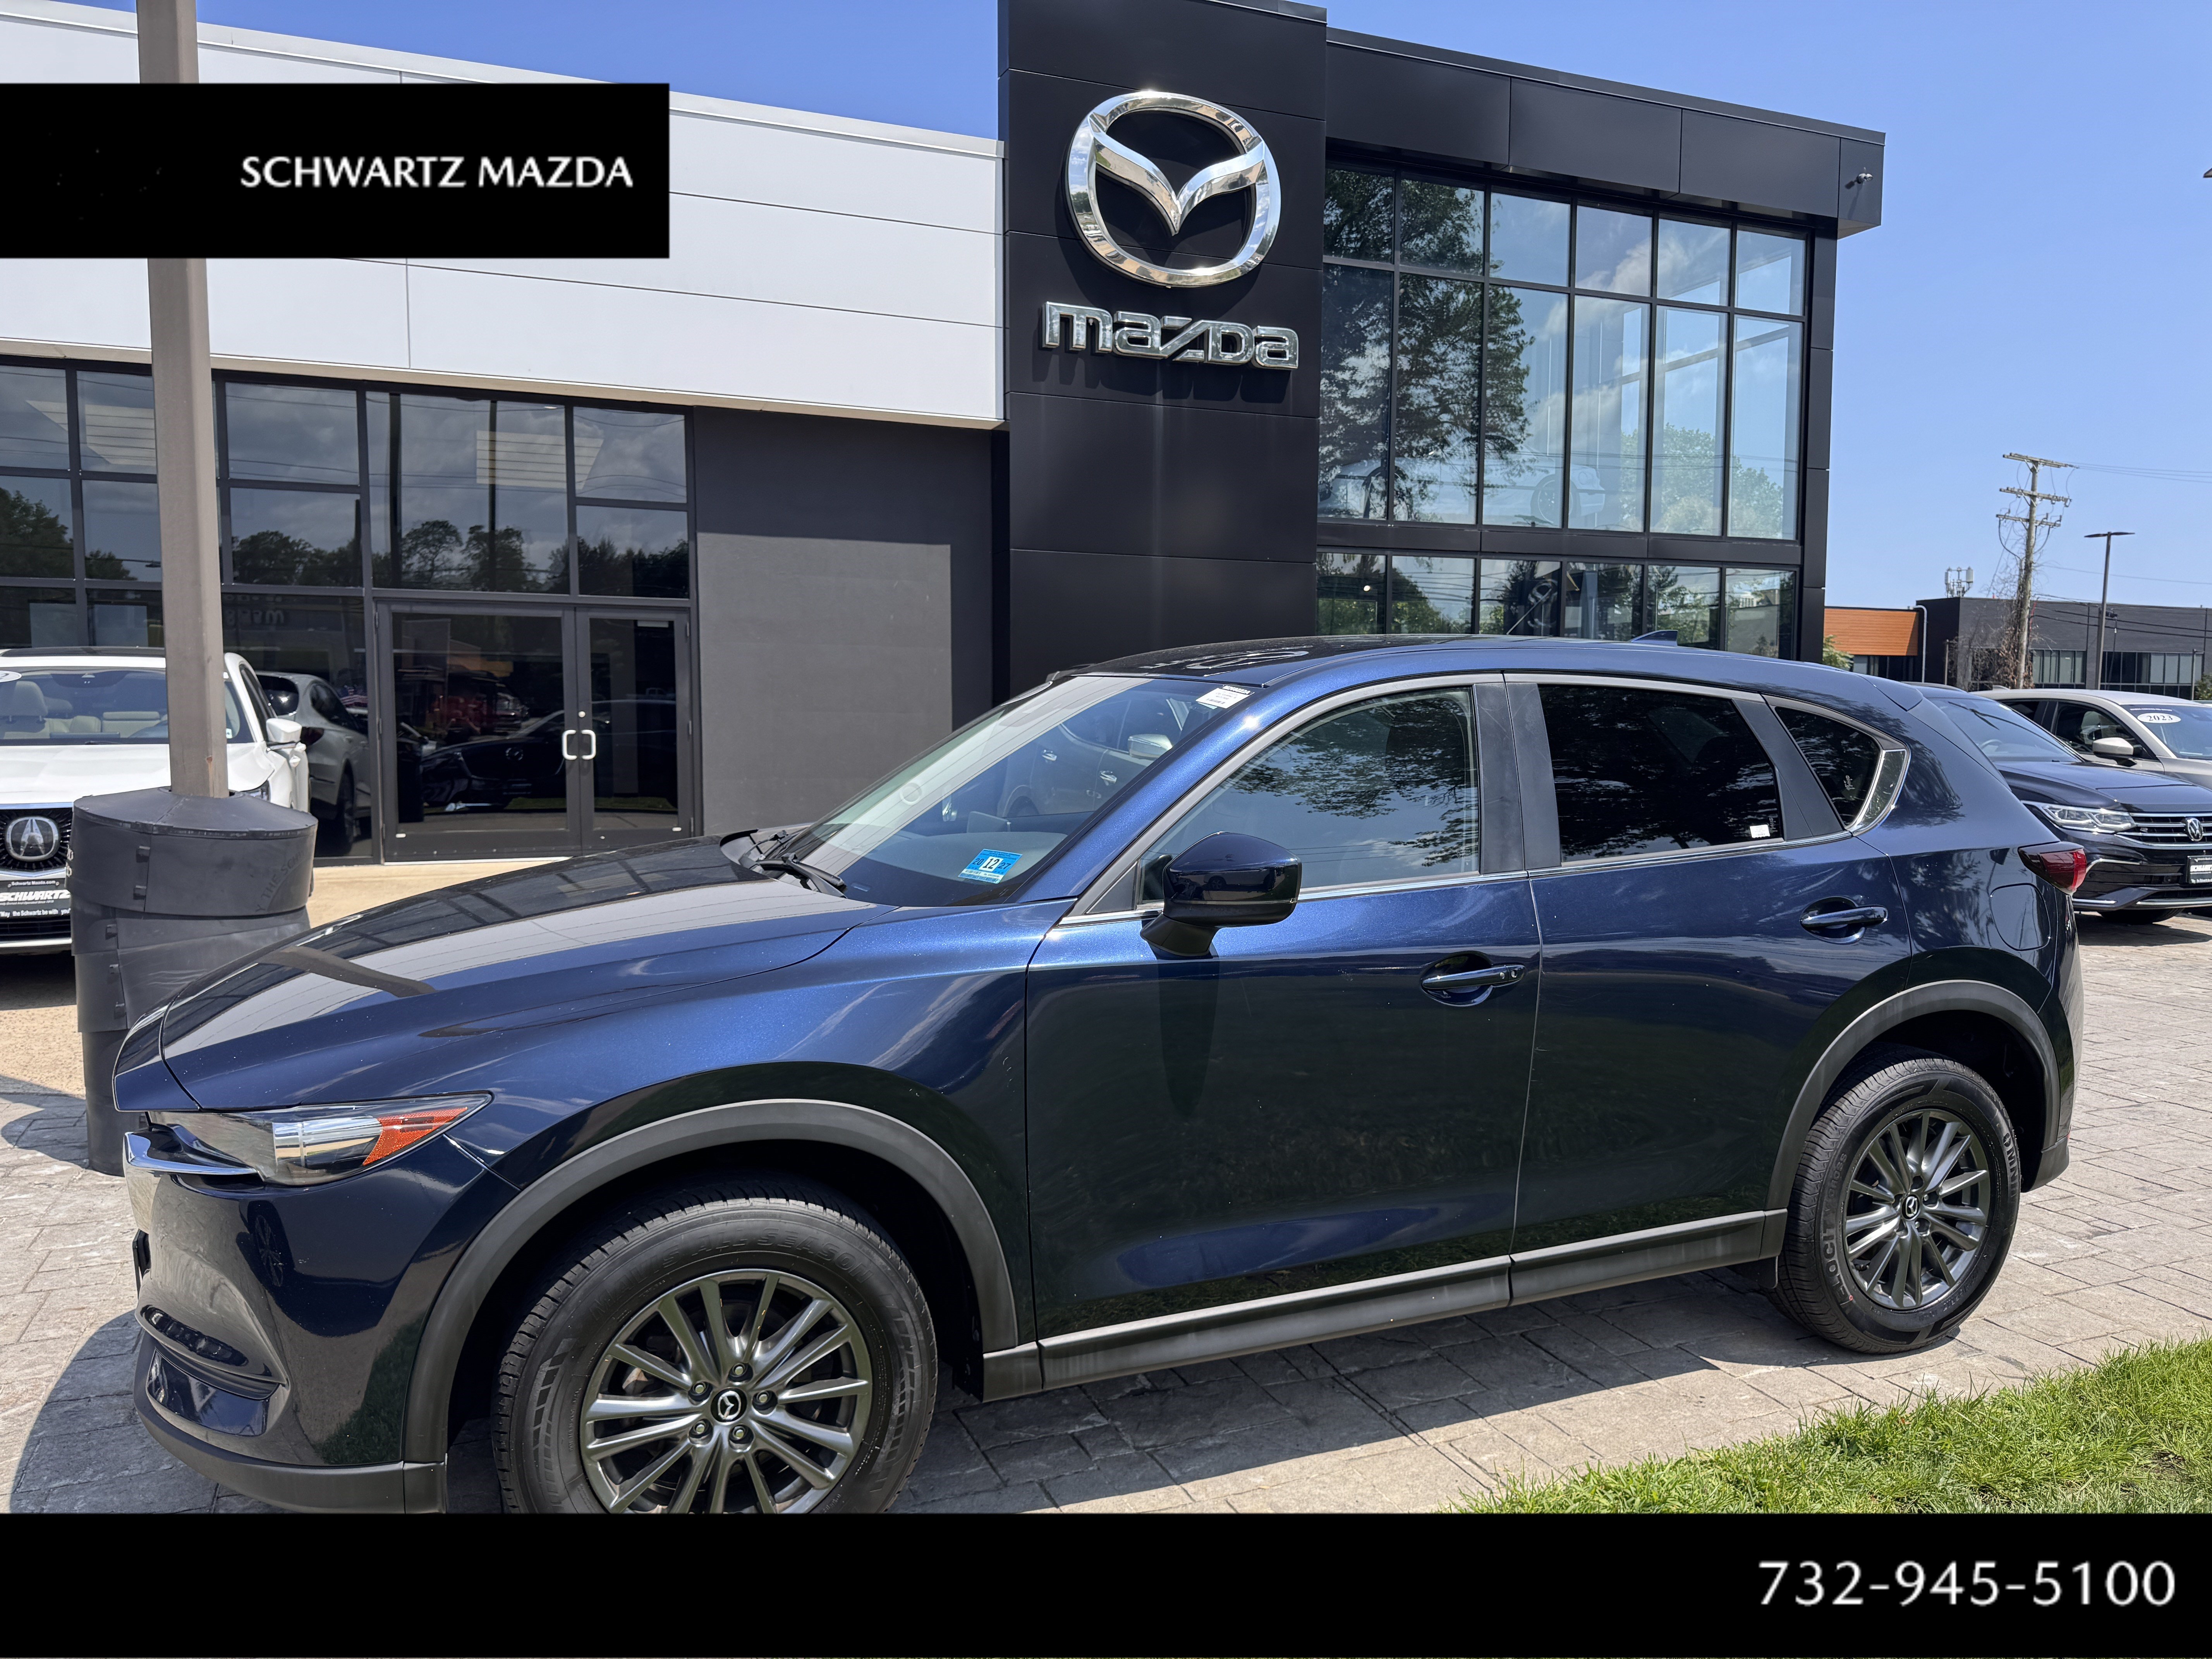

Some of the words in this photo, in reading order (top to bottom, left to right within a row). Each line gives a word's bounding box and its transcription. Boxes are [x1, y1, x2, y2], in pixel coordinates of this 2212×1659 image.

[982, 858, 1000, 869] 12
[0, 889, 71, 902] SCHWARTZ
[757, 1227, 876, 1284] SEASON
